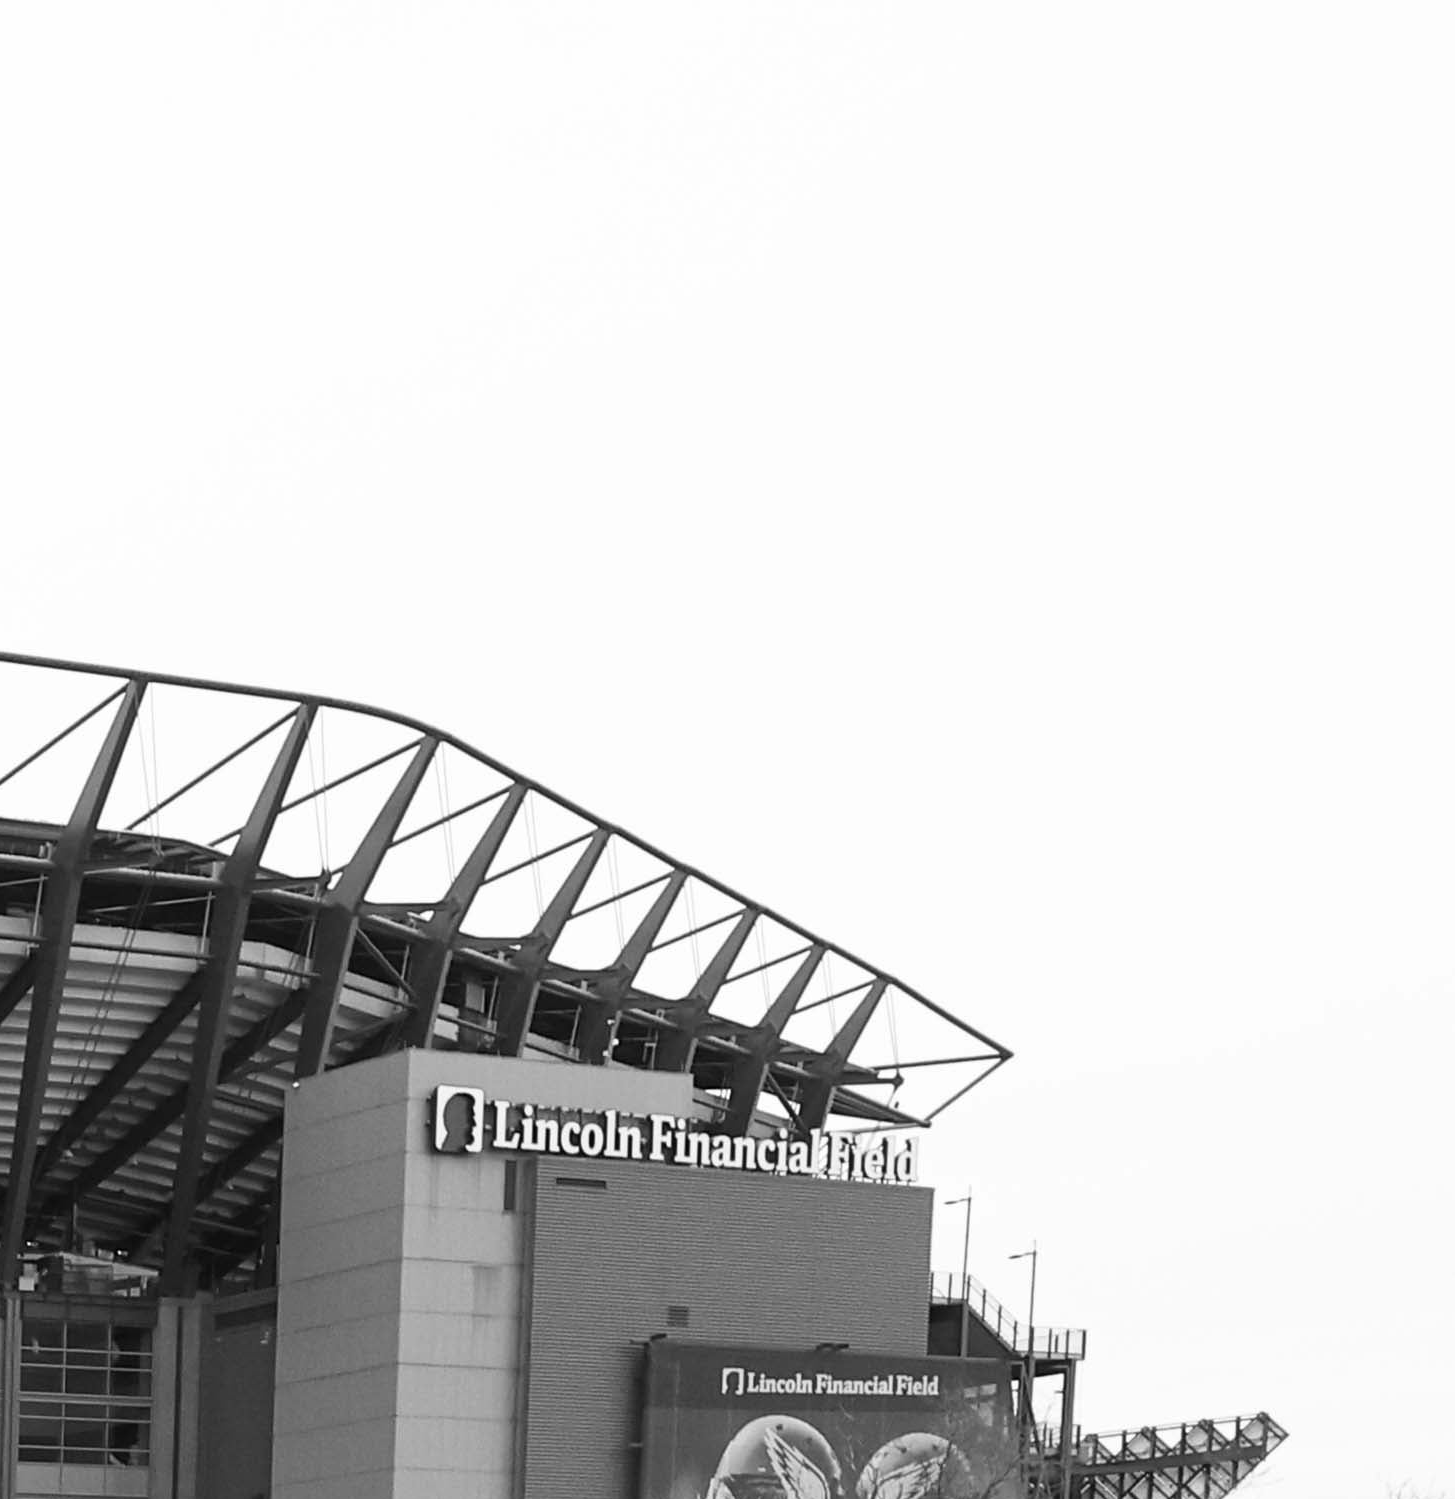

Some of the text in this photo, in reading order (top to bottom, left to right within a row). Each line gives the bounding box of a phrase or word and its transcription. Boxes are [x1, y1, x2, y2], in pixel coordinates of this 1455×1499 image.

[493, 1101, 920, 1182] Lincoln Financial Field
[747, 1372, 939, 1396] Lincoln Financial Field
